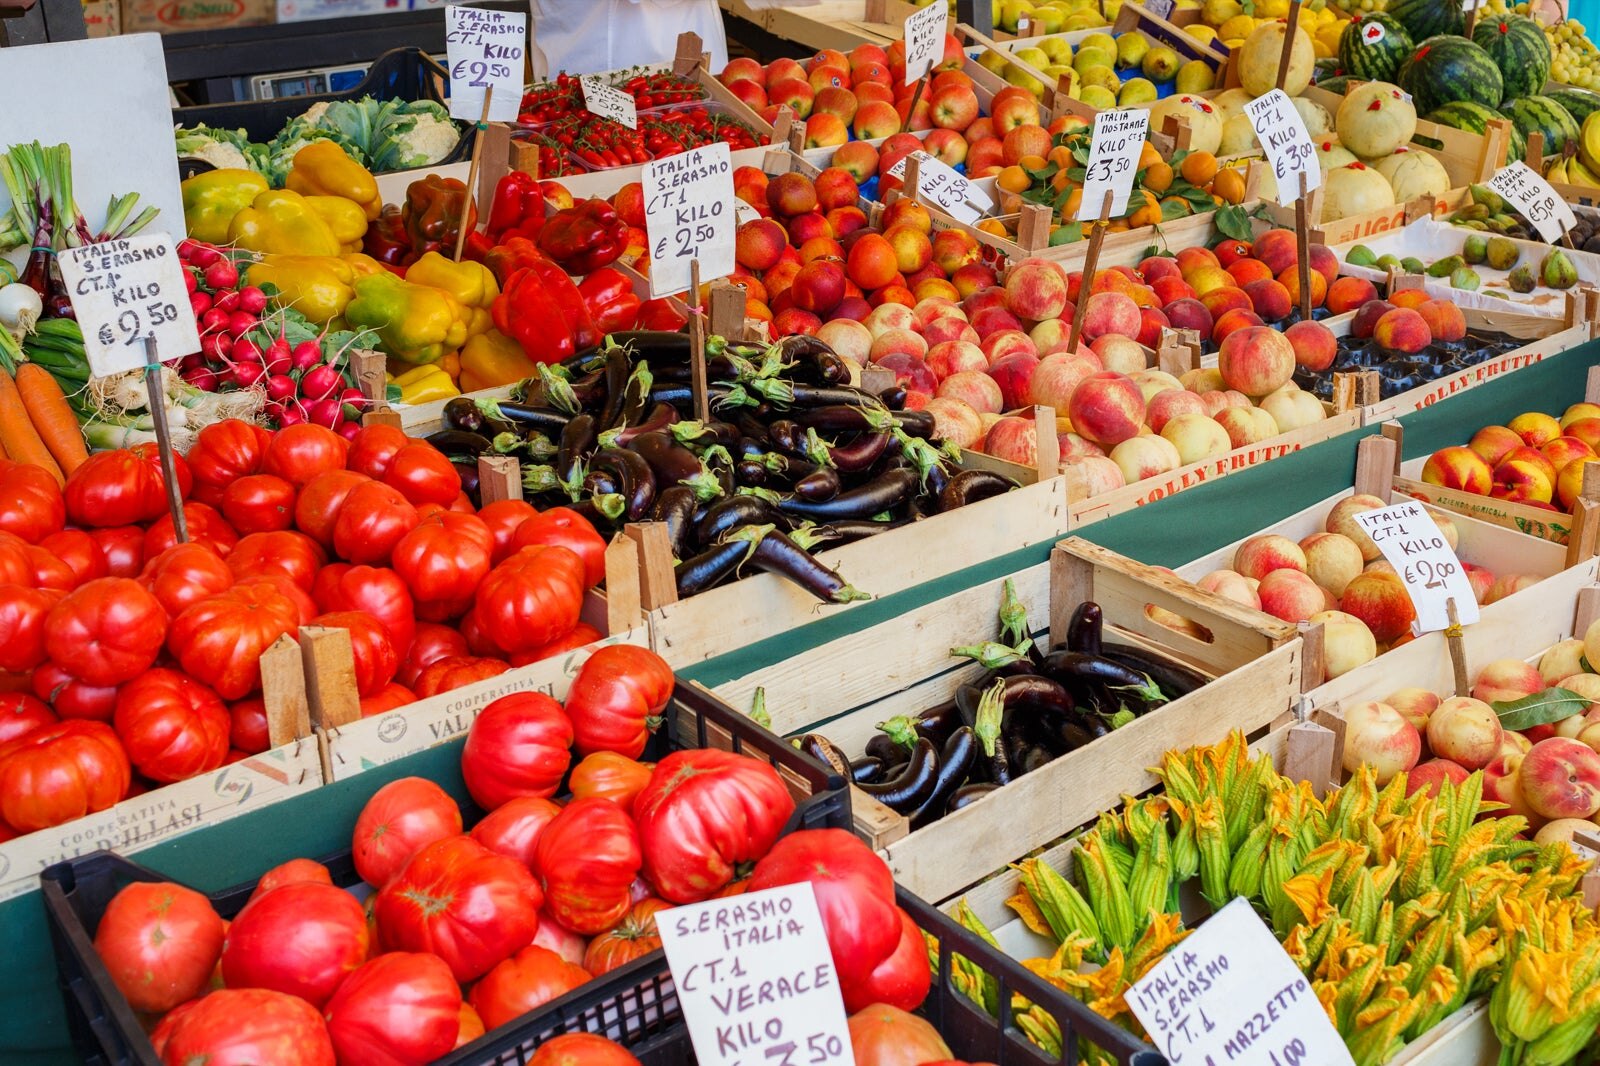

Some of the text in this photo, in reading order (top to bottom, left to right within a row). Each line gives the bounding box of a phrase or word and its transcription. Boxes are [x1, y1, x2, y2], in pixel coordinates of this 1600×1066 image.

[913, 25, 934, 46] KILO
[483, 43, 522, 60] KILO
[1100, 112, 1129, 122] ITALIA
[1098, 138, 1126, 155] KILO
[1268, 126, 1296, 150] KILO
[921, 174, 947, 195] KILO
[1518, 185, 1541, 204] KILO
[676, 201, 723, 226] KILO
[111, 282, 161, 308] KILO
[1399, 537, 1443, 556] KILO
[446, 677, 535, 714] COOPERATIVA
[428, 713, 469, 740] VAL
[60, 799, 177, 848] COOPERATIVA
[710, 963, 830, 1016] VERACE
[1223, 979, 1307, 1061] MAZZETTO
[716, 1017, 783, 1058] KILO
